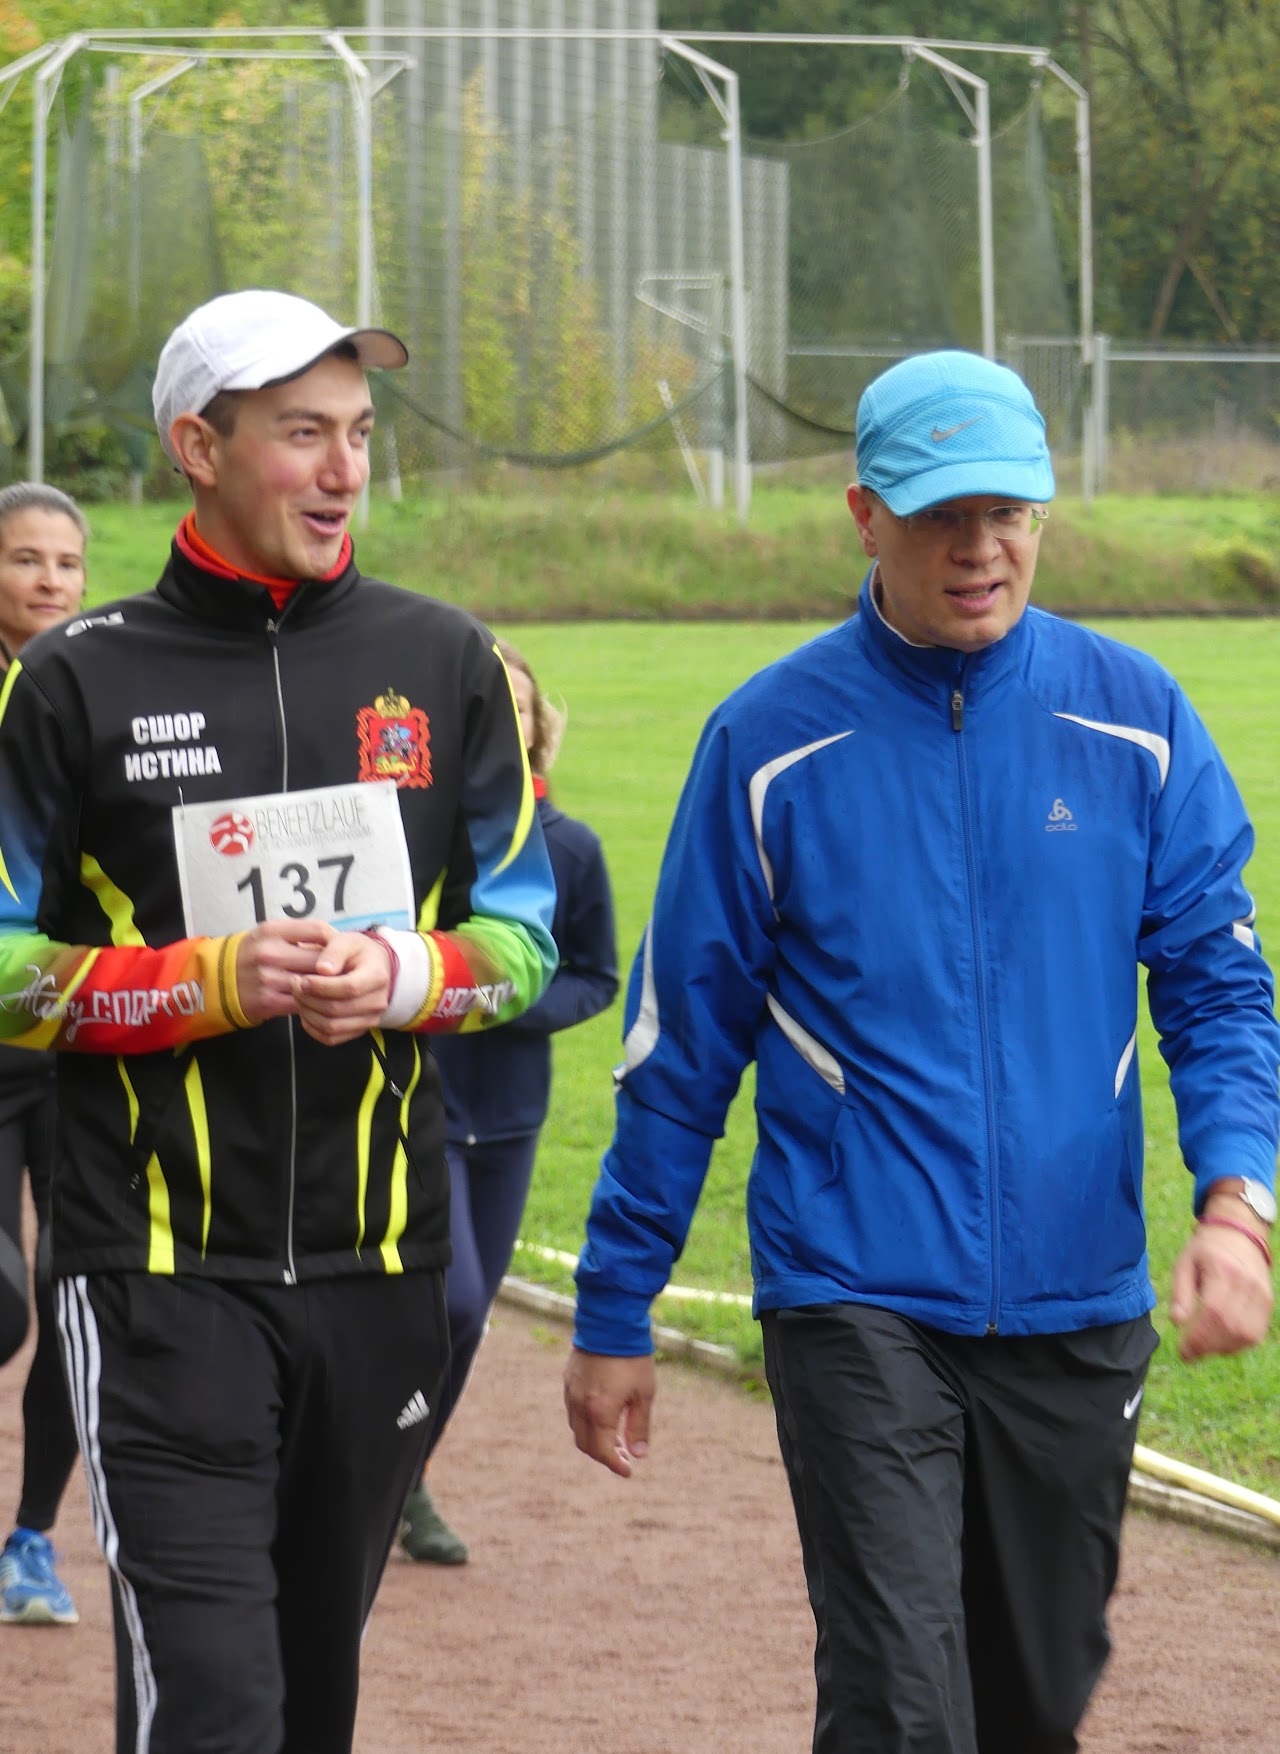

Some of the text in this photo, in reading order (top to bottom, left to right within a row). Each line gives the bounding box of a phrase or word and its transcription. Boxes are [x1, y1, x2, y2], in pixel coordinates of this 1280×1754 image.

[131, 711, 207, 746] СШОР
[124, 746, 223, 783] ИСТИНА
[254, 795, 365, 841] BENEFIZLAUF
[237, 853, 356, 925] 137
